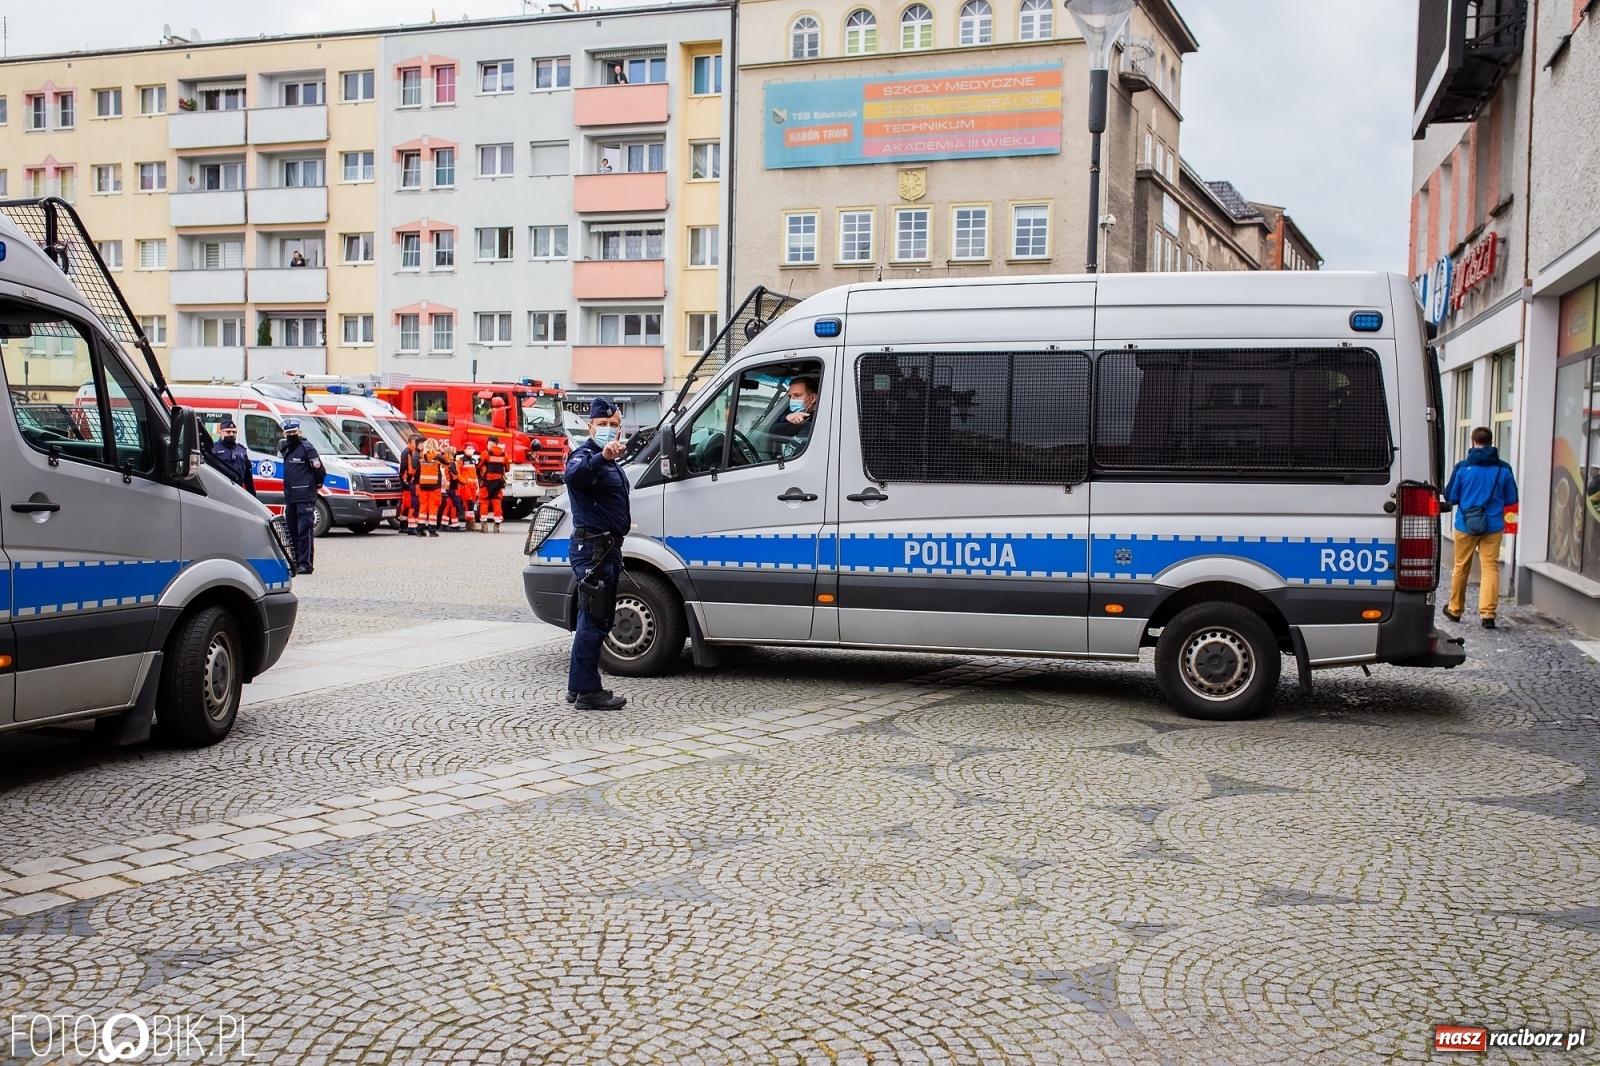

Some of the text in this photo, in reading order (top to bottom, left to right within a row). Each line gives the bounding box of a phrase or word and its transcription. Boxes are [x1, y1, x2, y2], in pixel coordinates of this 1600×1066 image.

[883, 77, 1035, 95] SZKOŁY MEDYCZNE
[883, 95, 1044, 114] SZKOŁY POLICEALNE
[792, 112, 811, 120] TEB
[813, 109, 857, 119] Edukacja
[883, 119, 975, 133] TECHNIKUM
[789, 128, 848, 142] NABÓR TRWA
[882, 136, 1035, 153] AKADEMIA III WIEKU
[904, 541, 1017, 567] POLICJA
[1320, 548, 1389, 573] R805
